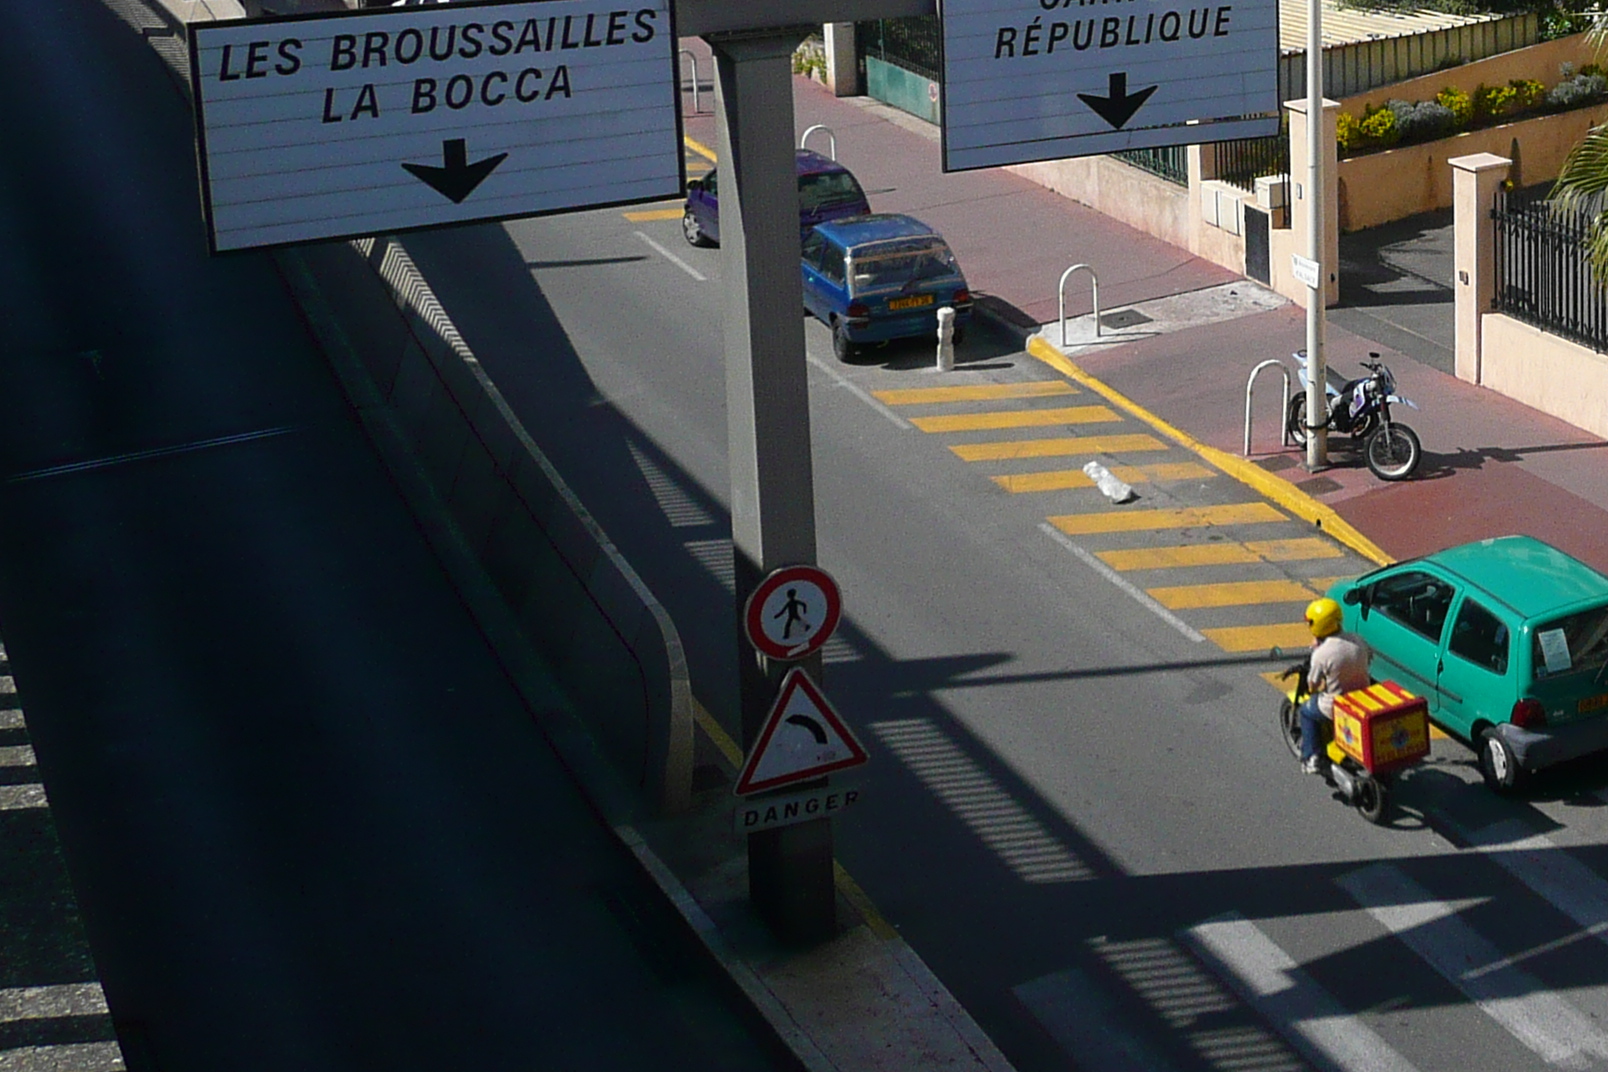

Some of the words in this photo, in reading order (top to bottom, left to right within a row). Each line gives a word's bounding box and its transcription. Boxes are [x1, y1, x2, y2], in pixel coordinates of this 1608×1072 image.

[219, 37, 303, 82] LES
[330, 8, 657, 72] BROUSSAILLES
[994, 5, 1232, 59] RÉPUBLIQUE
[322, 84, 380, 124] LA
[411, 65, 572, 115] BOCCA
[744, 790, 859, 827] DANGER
